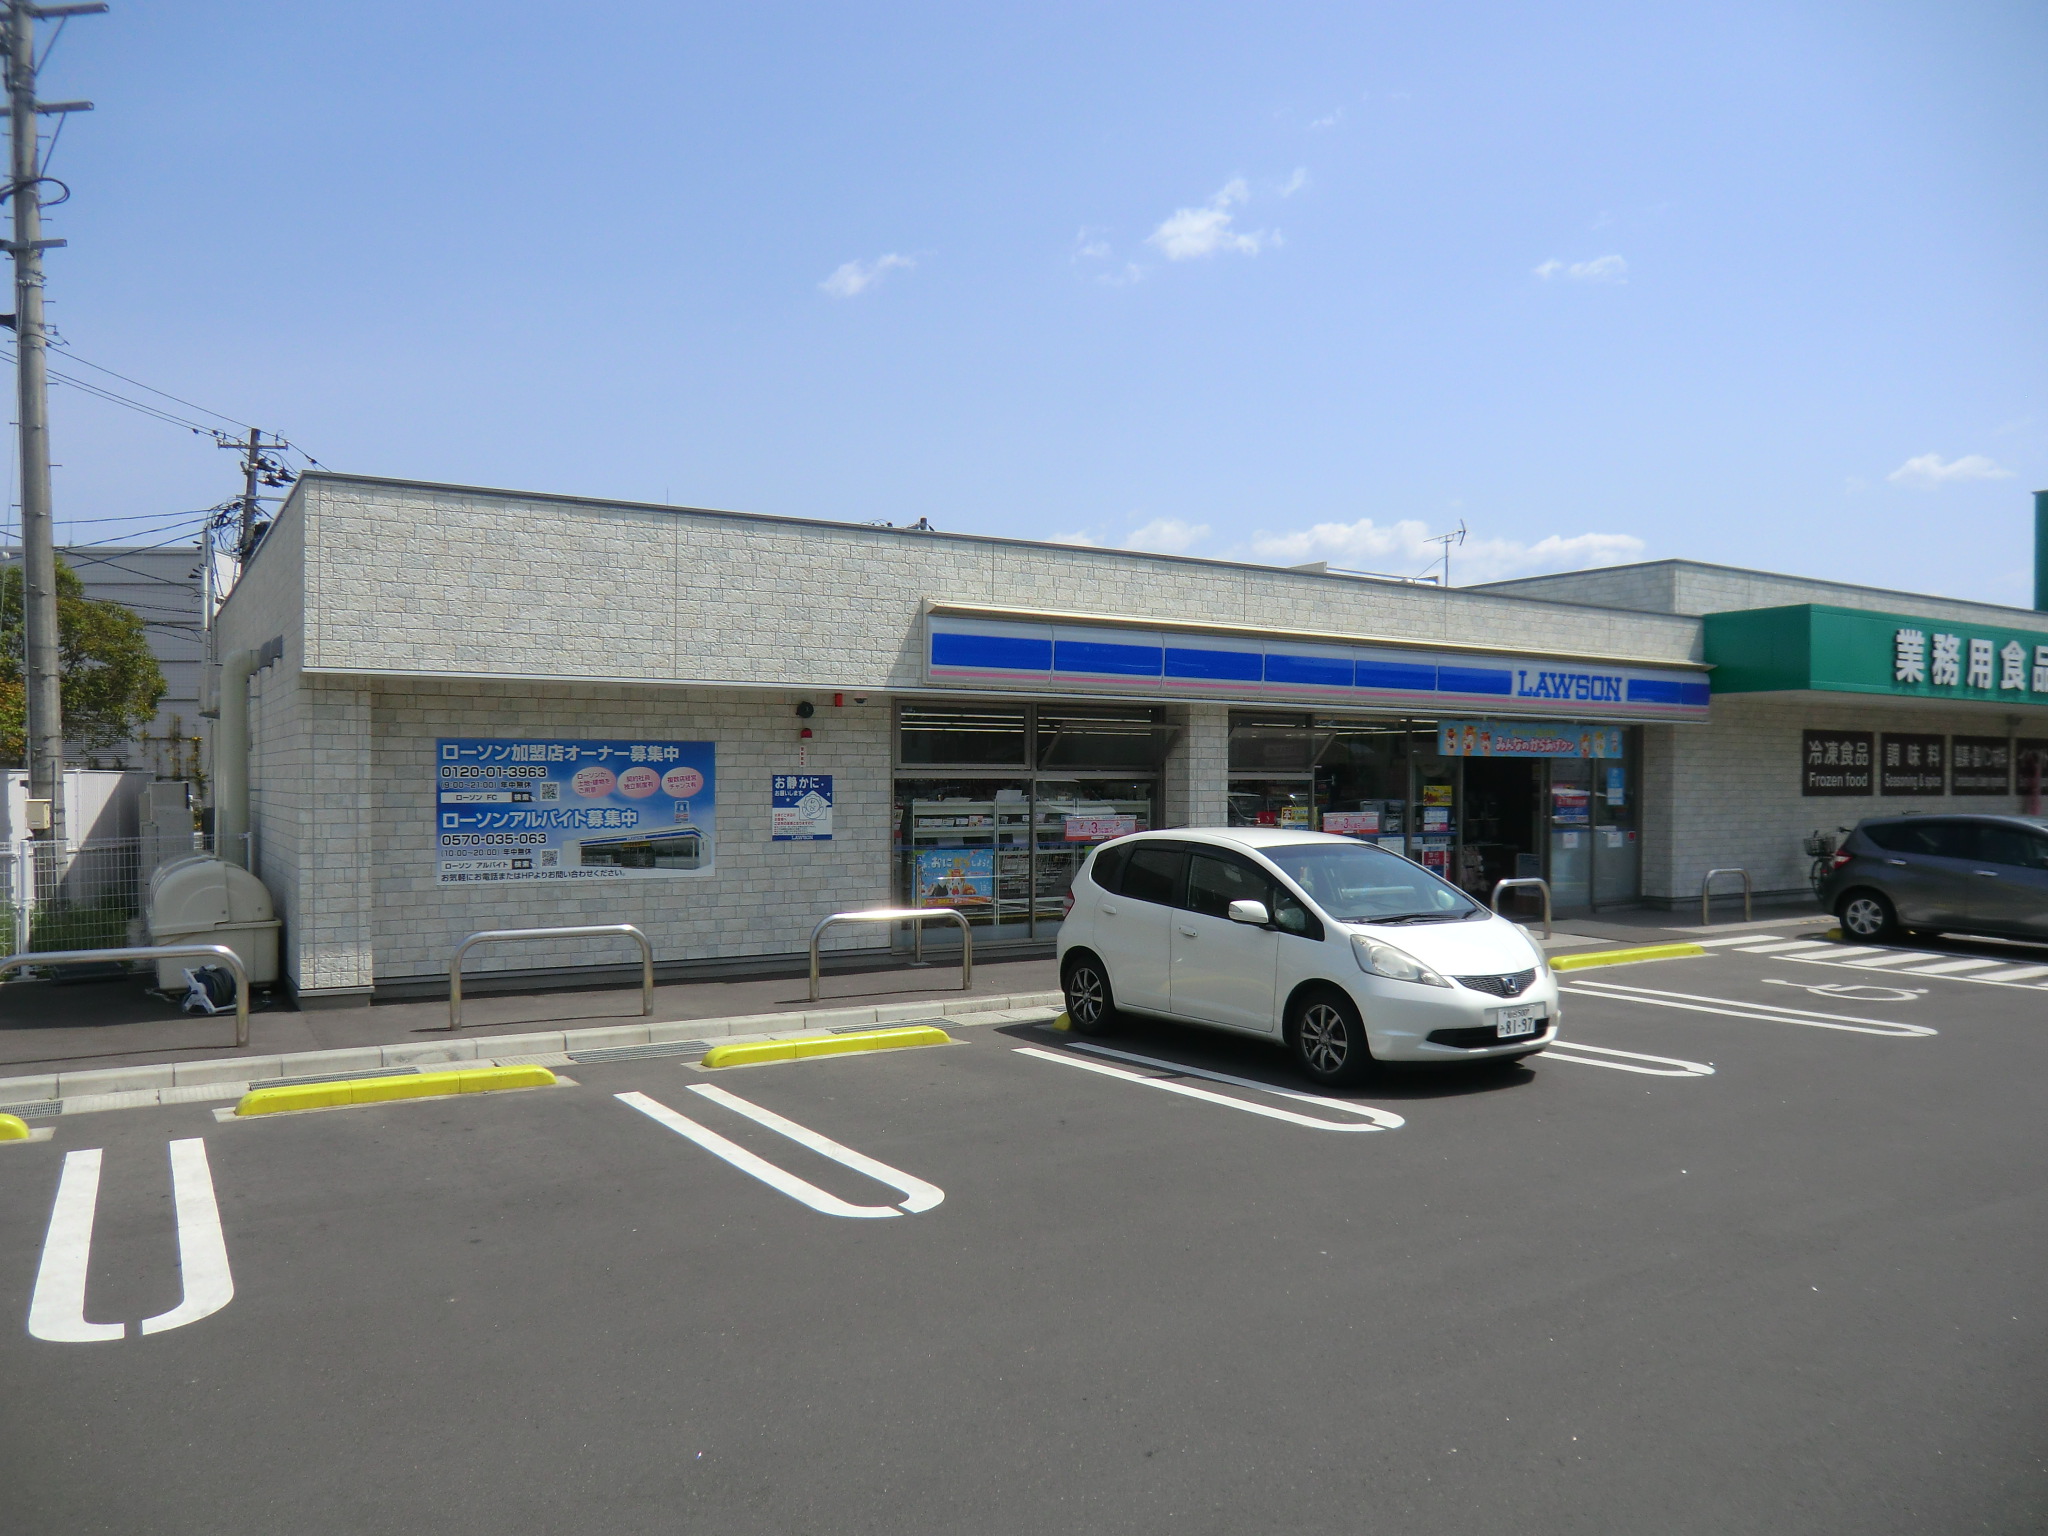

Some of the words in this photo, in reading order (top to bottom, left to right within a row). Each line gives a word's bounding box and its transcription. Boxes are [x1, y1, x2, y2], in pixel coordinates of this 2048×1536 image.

[1517, 670, 1622, 701] LAWSON
[442, 744, 679, 762] ローソン加盟店オーナー募集中
[1808, 740, 1869, 766] 冷凍食品
[441, 766, 548, 779] 0120-01-3963
[1809, 772, 1844, 787] Frozen
[1846, 772, 1868, 787] food
[774, 776, 820, 789] お静かに
[442, 809, 637, 828] ローソンアルバイト募集中
[441, 833, 548, 846] 0570-035-063
[441, 870, 626, 882] お気軽にお電話またはHPよりお問い合わせください。
[1506, 1017, 1533, 1034] 81-97
